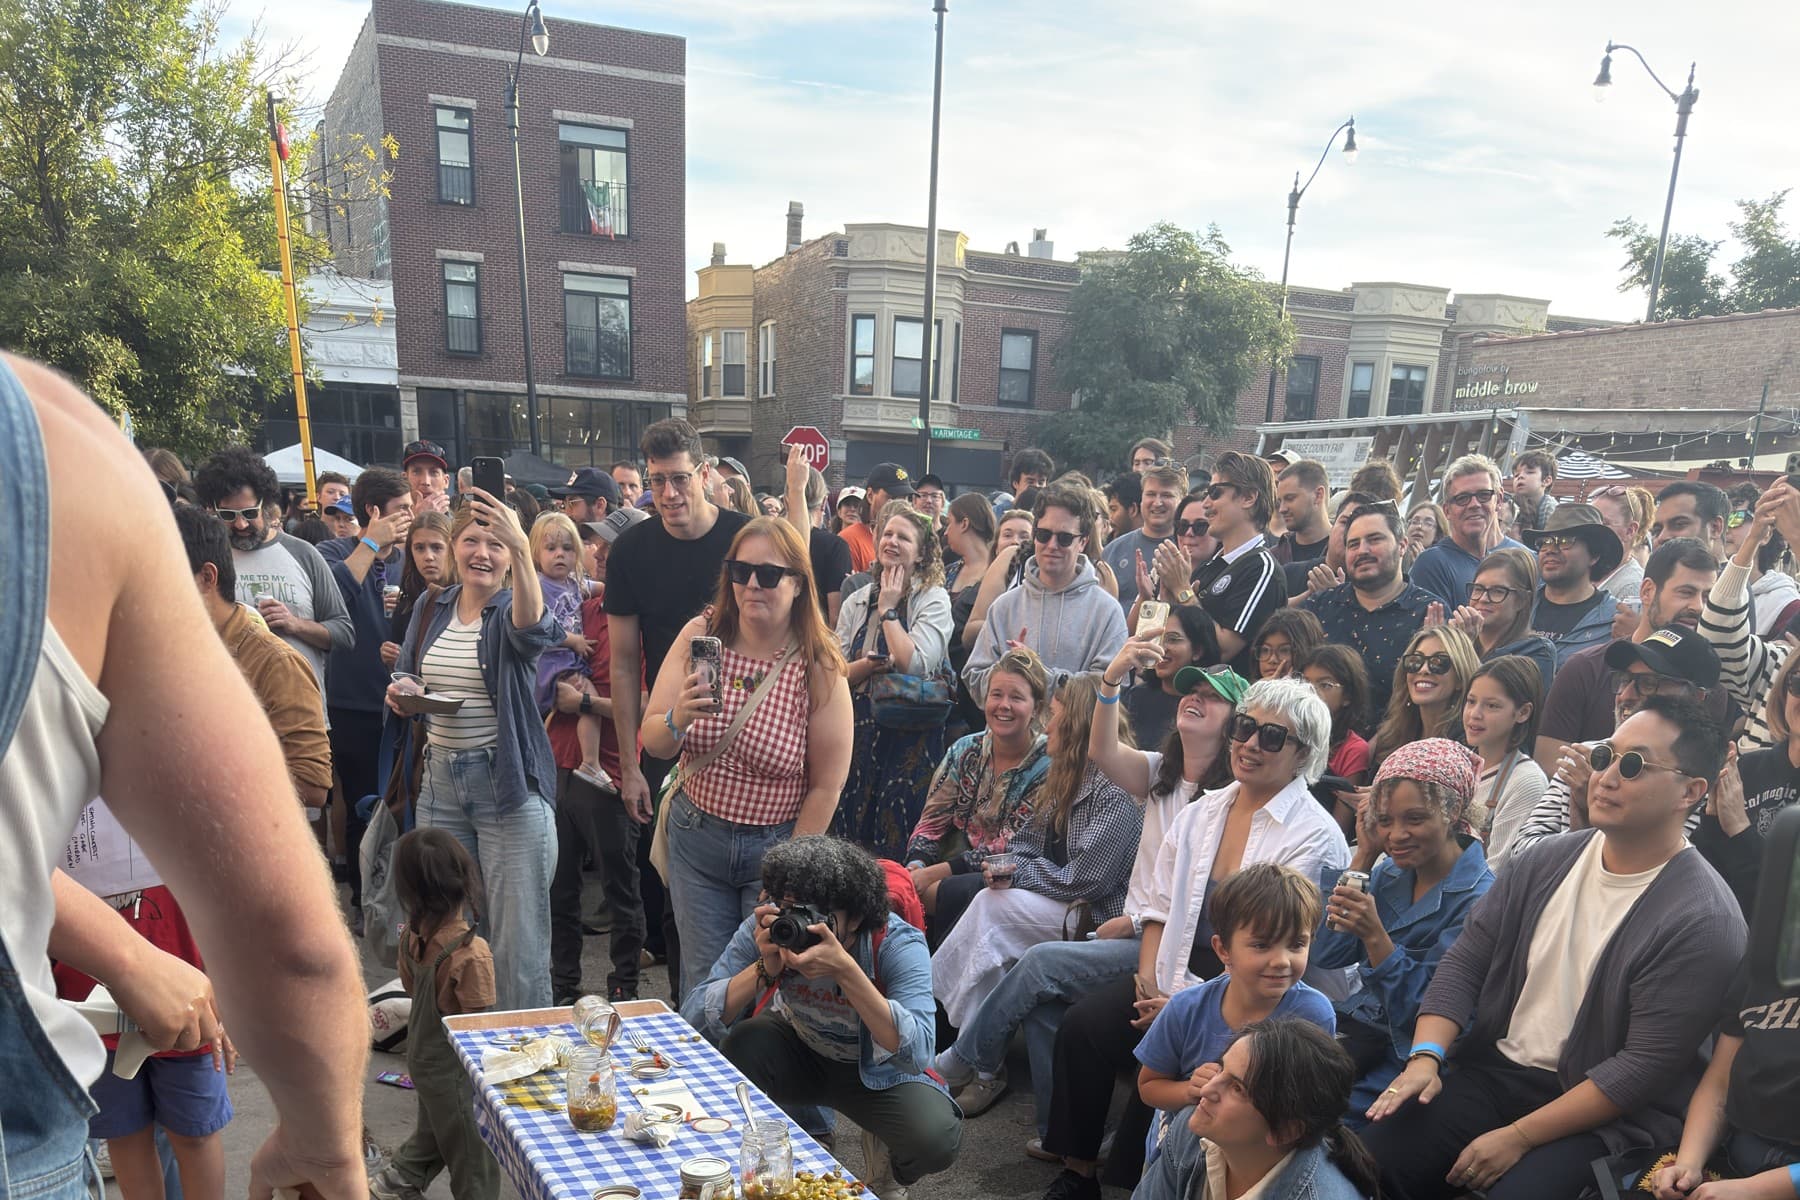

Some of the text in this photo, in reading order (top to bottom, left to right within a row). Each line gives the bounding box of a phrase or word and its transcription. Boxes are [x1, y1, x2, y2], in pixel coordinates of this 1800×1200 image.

[1455, 379, 1538, 399] middle brow
[939, 429, 973, 439] ARMITAGE
[263, 581, 298, 604] PLACE
[1761, 784, 1797, 803] magic
